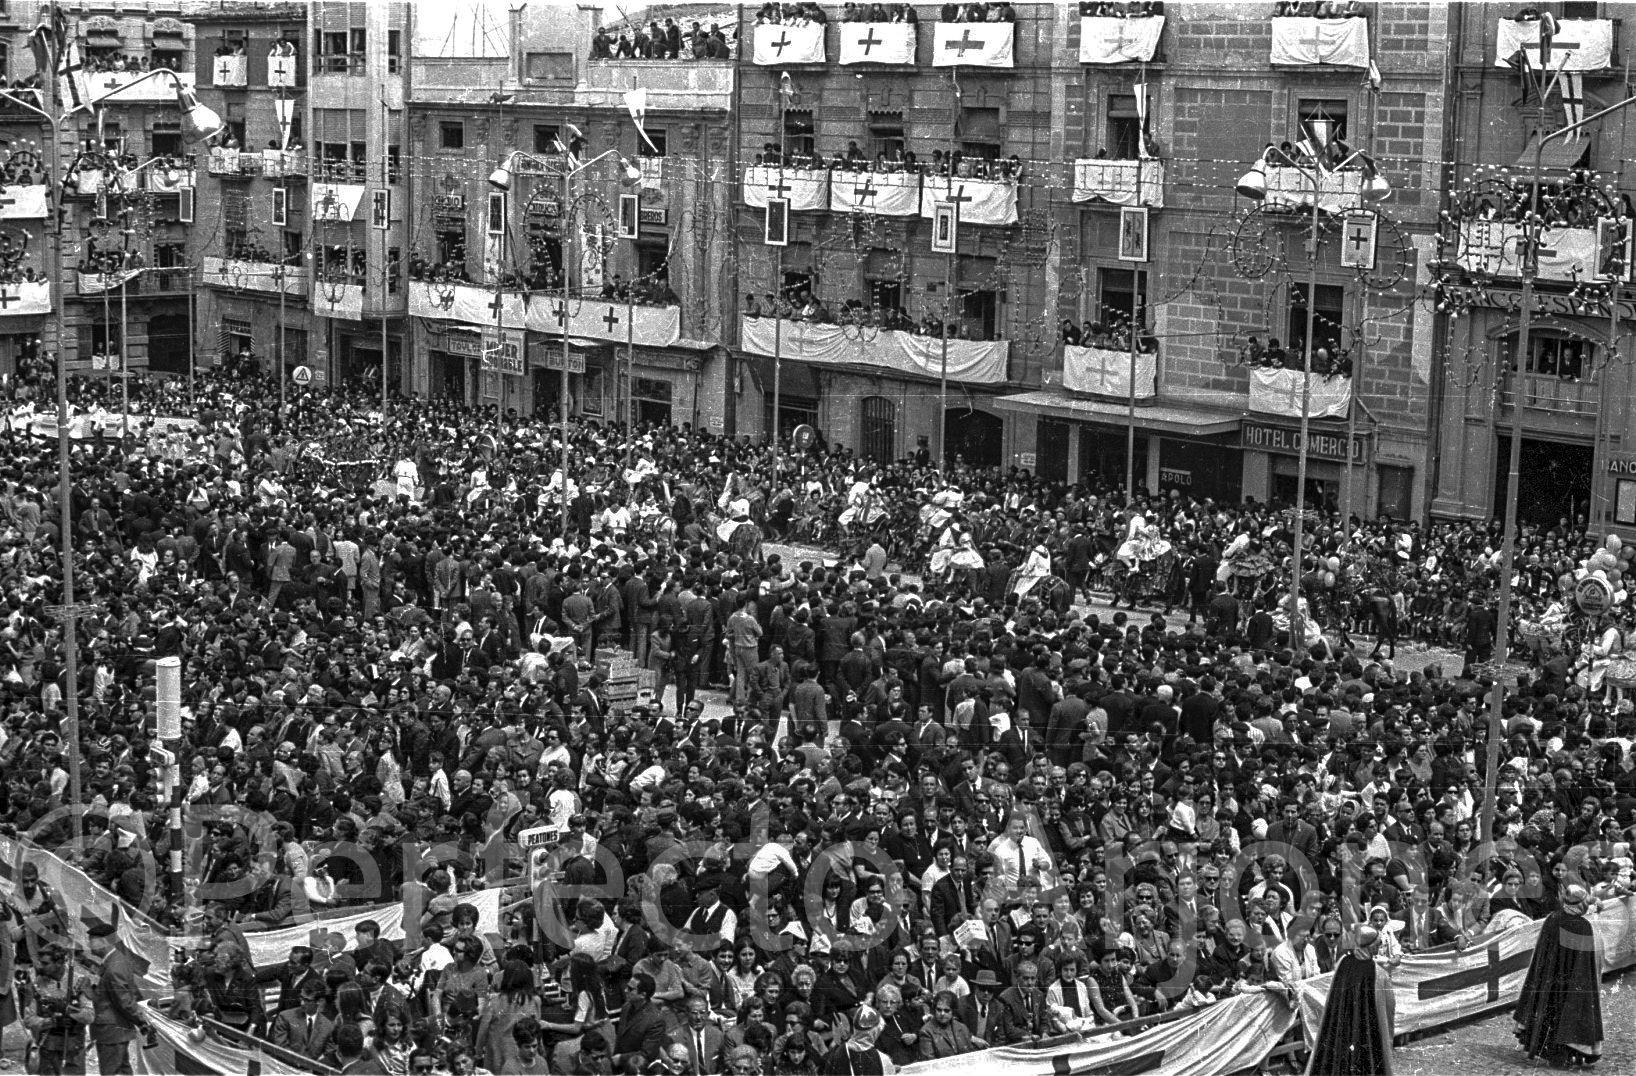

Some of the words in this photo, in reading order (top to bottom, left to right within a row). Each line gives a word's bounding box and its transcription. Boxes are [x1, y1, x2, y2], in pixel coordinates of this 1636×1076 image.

[1246, 426, 1290, 449] HOTEL
[1292, 432, 1359, 458] CMERCO
[1161, 472, 1192, 486] APOLO
[527, 829, 558, 846] PEATONES
